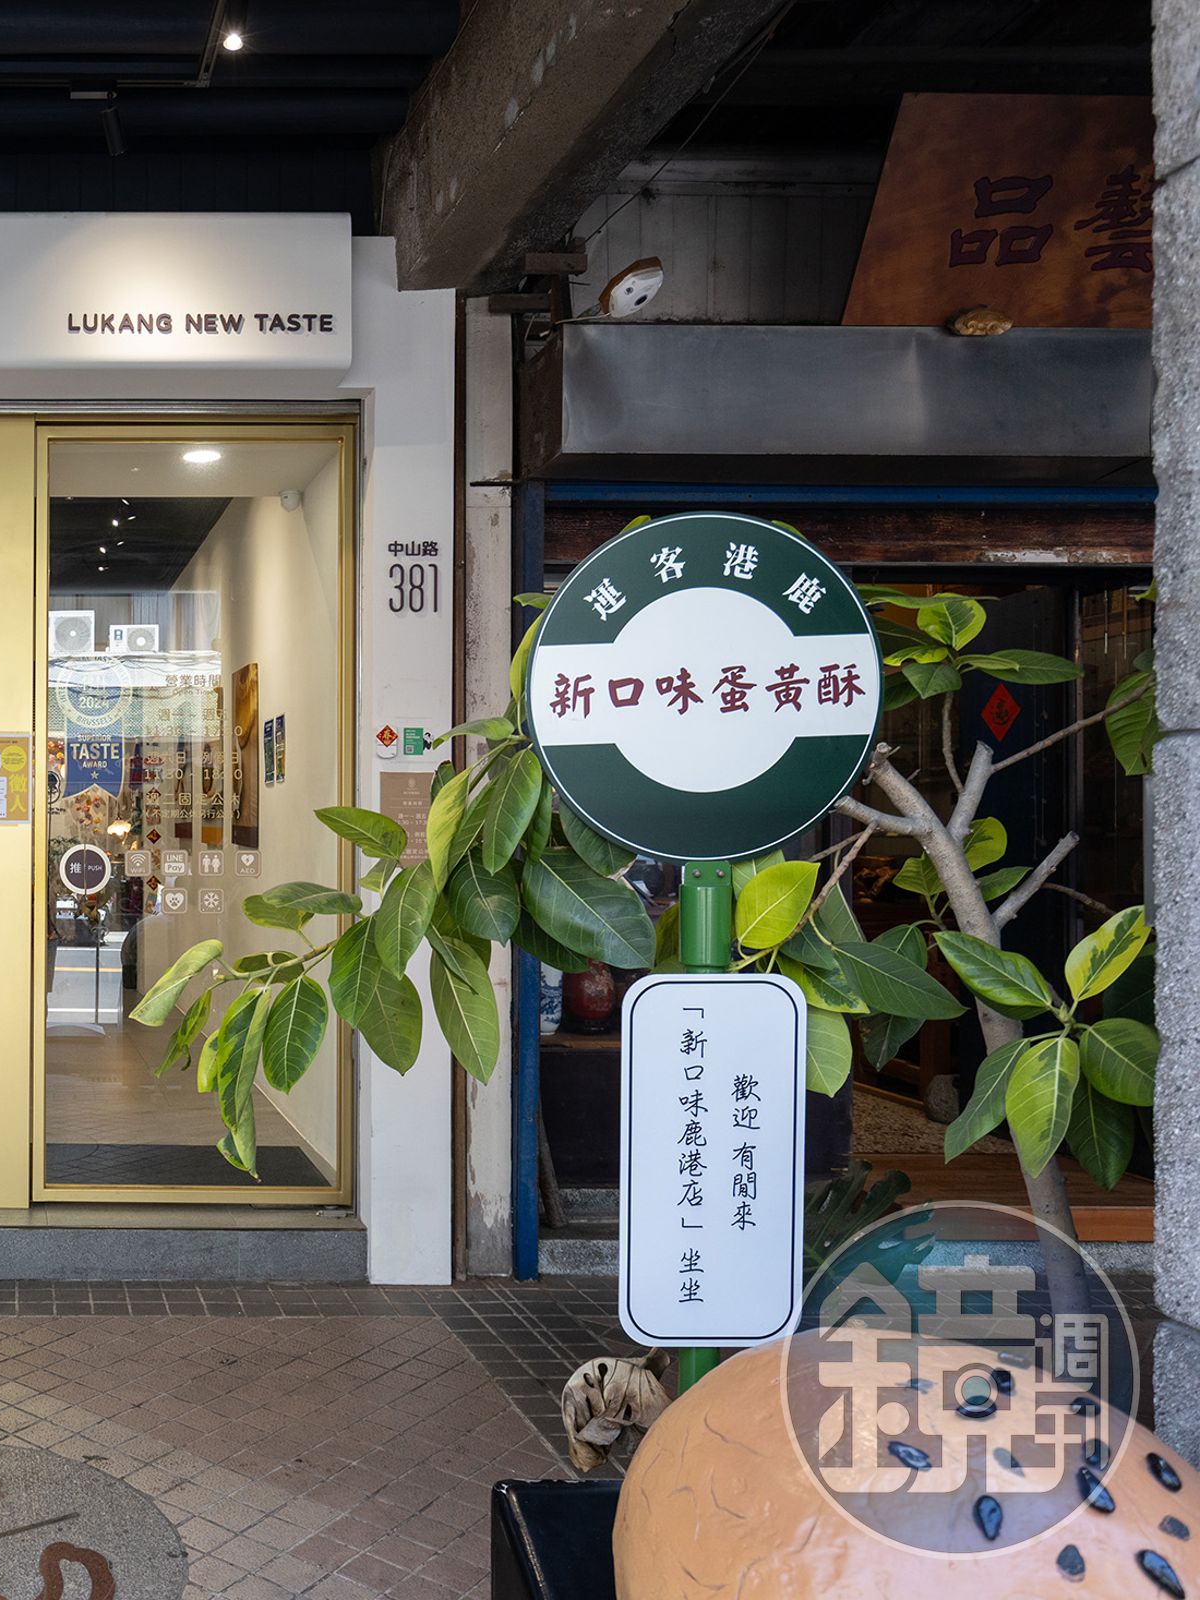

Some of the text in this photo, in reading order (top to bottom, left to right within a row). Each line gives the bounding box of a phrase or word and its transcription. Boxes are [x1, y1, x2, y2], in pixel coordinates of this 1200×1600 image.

[68, 313, 334, 332] LUKANG NEW TASTE
[388, 540, 439, 557] 中山路
[388, 563, 439, 613] 381
[549, 663, 866, 719] 新口味蛋黃酥
[70, 742, 120, 760] TASTE
[82, 760, 108, 769] AWARD
[166, 854, 184, 862] LINE
[69, 862, 82, 874] 推
[167, 864, 183, 873] Pay
